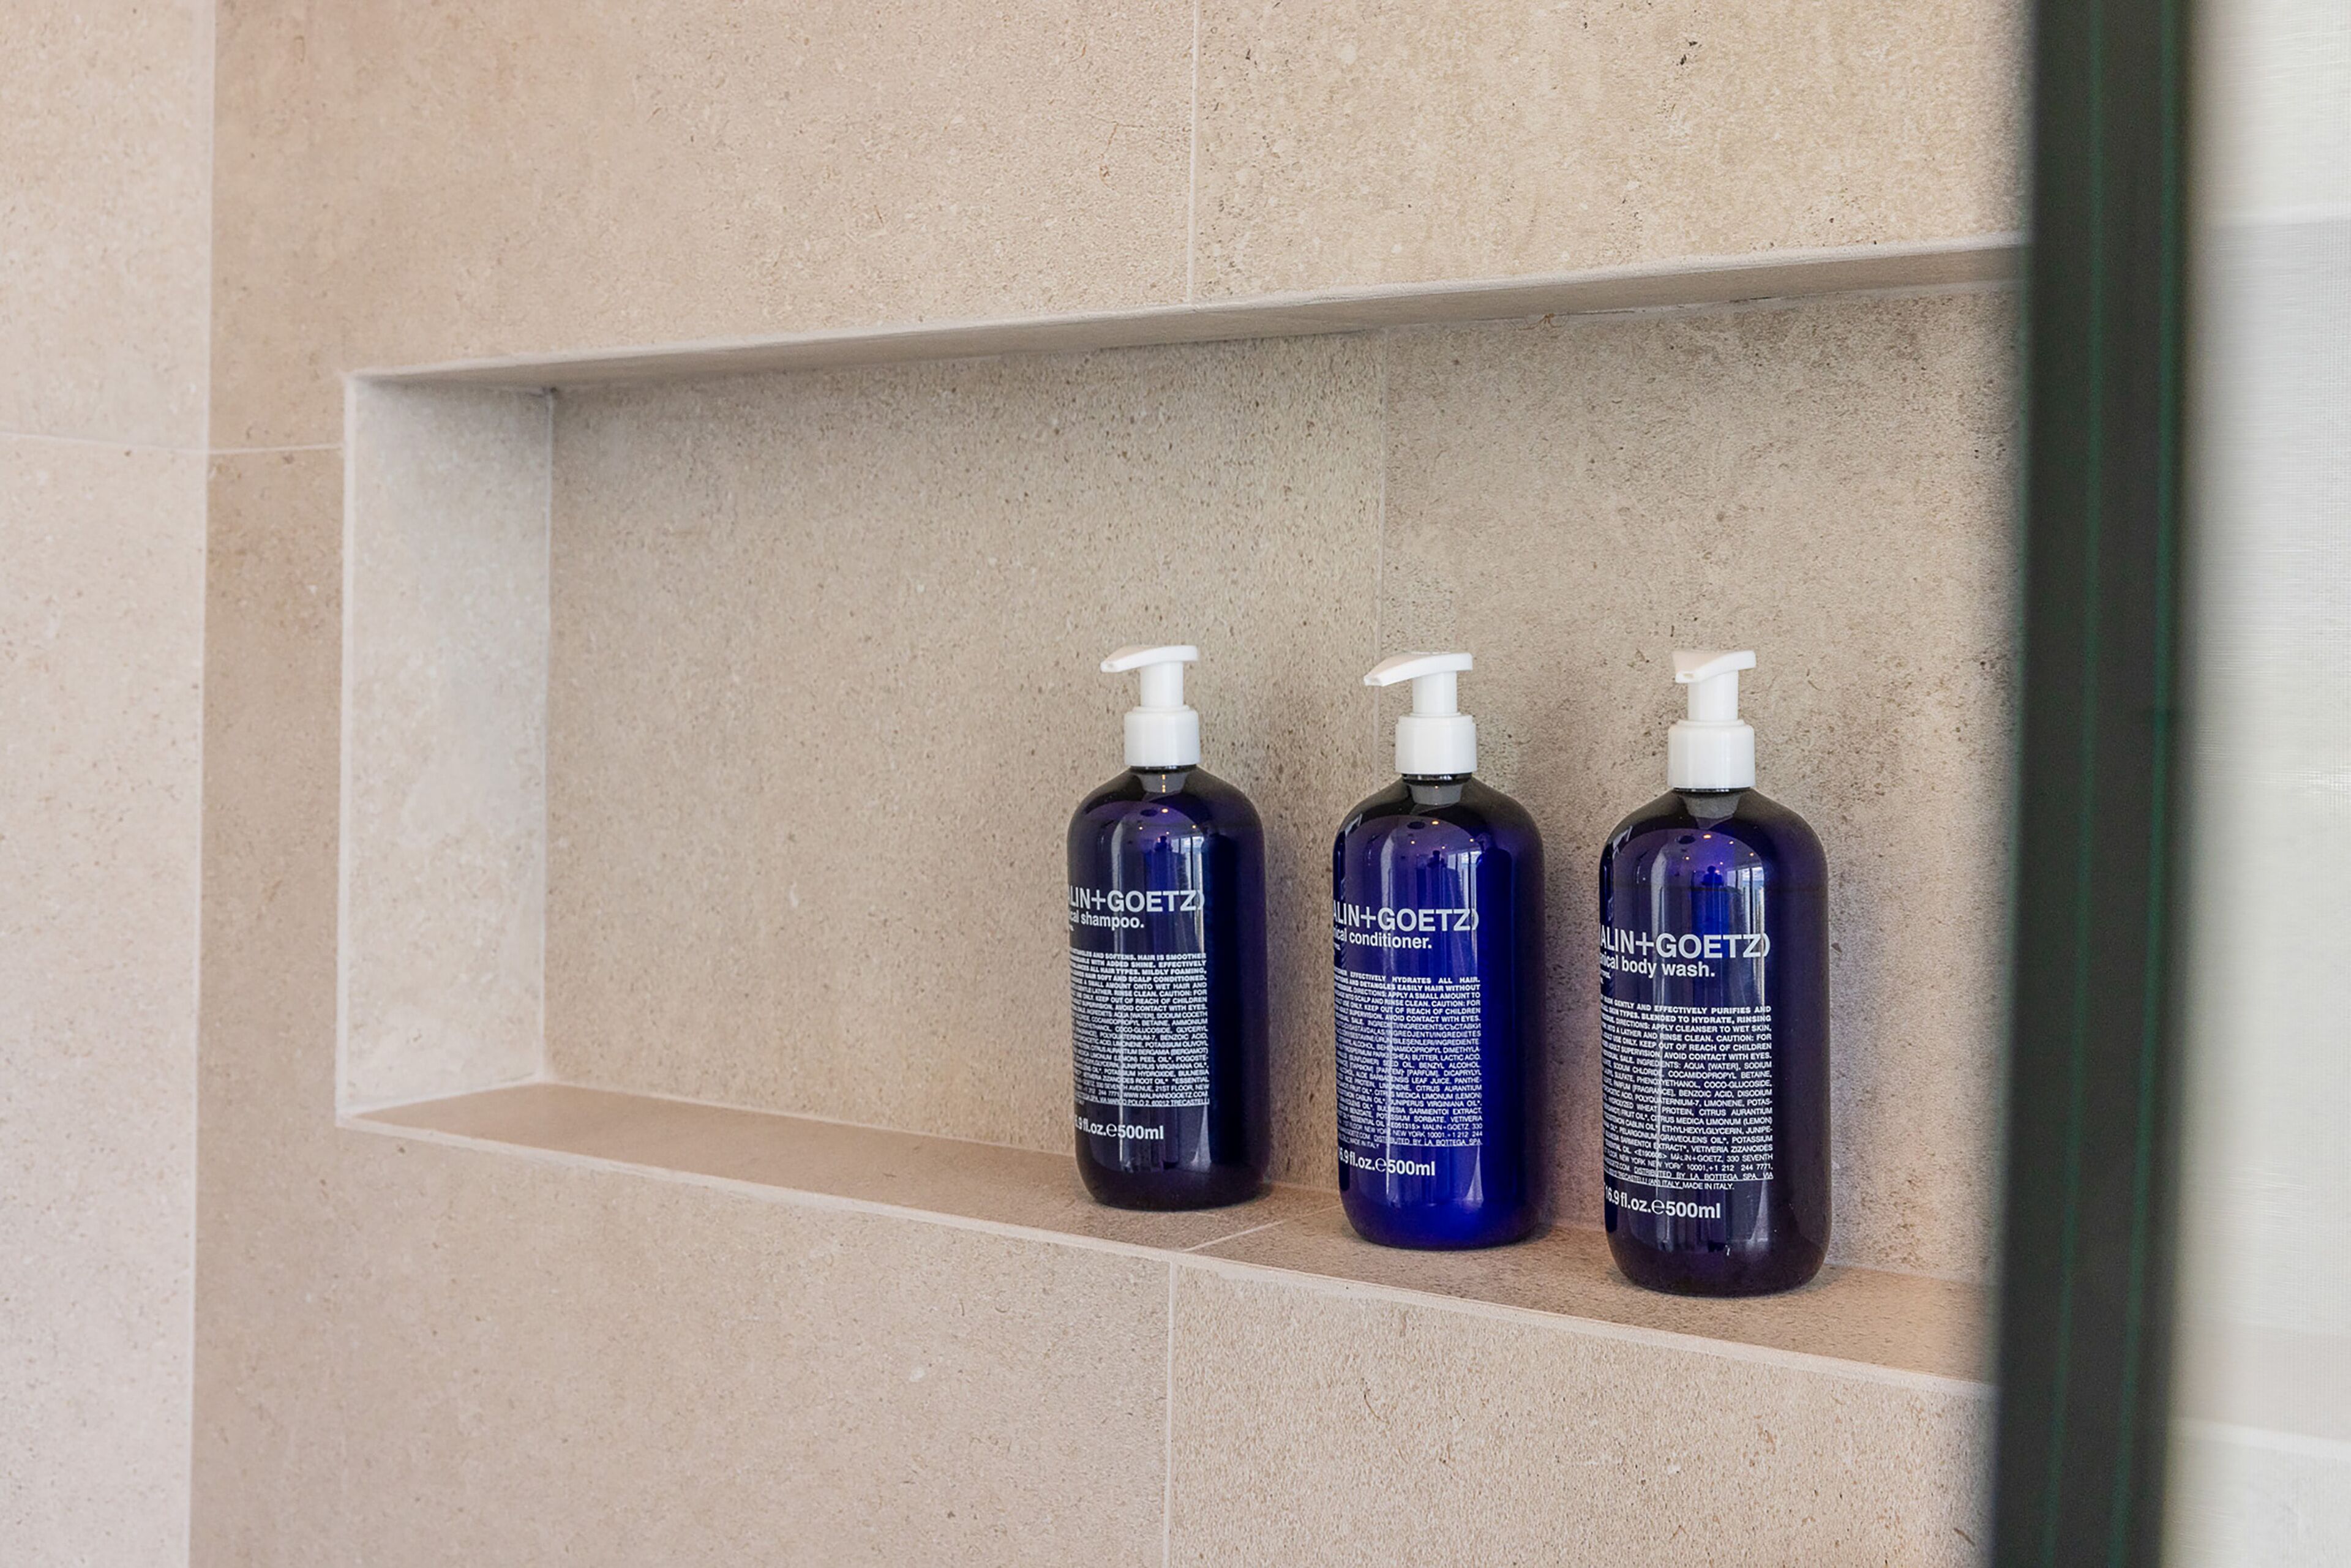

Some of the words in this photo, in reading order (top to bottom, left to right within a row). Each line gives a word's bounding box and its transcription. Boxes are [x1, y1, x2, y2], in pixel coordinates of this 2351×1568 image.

[1069, 886, 1205, 912] LIN+GOETZ)
[1081, 911, 1144, 931] shampoo.
[1349, 931, 1432, 949] conditioner.
[1622, 956, 1657, 978] body
[1662, 961, 1715, 977] wash.
[1641, 1013, 1676, 1022] BLENDED
[1654, 1005, 1708, 1014] EFFECTIVELY
[1733, 1043, 1772, 1051] CHILDREN
